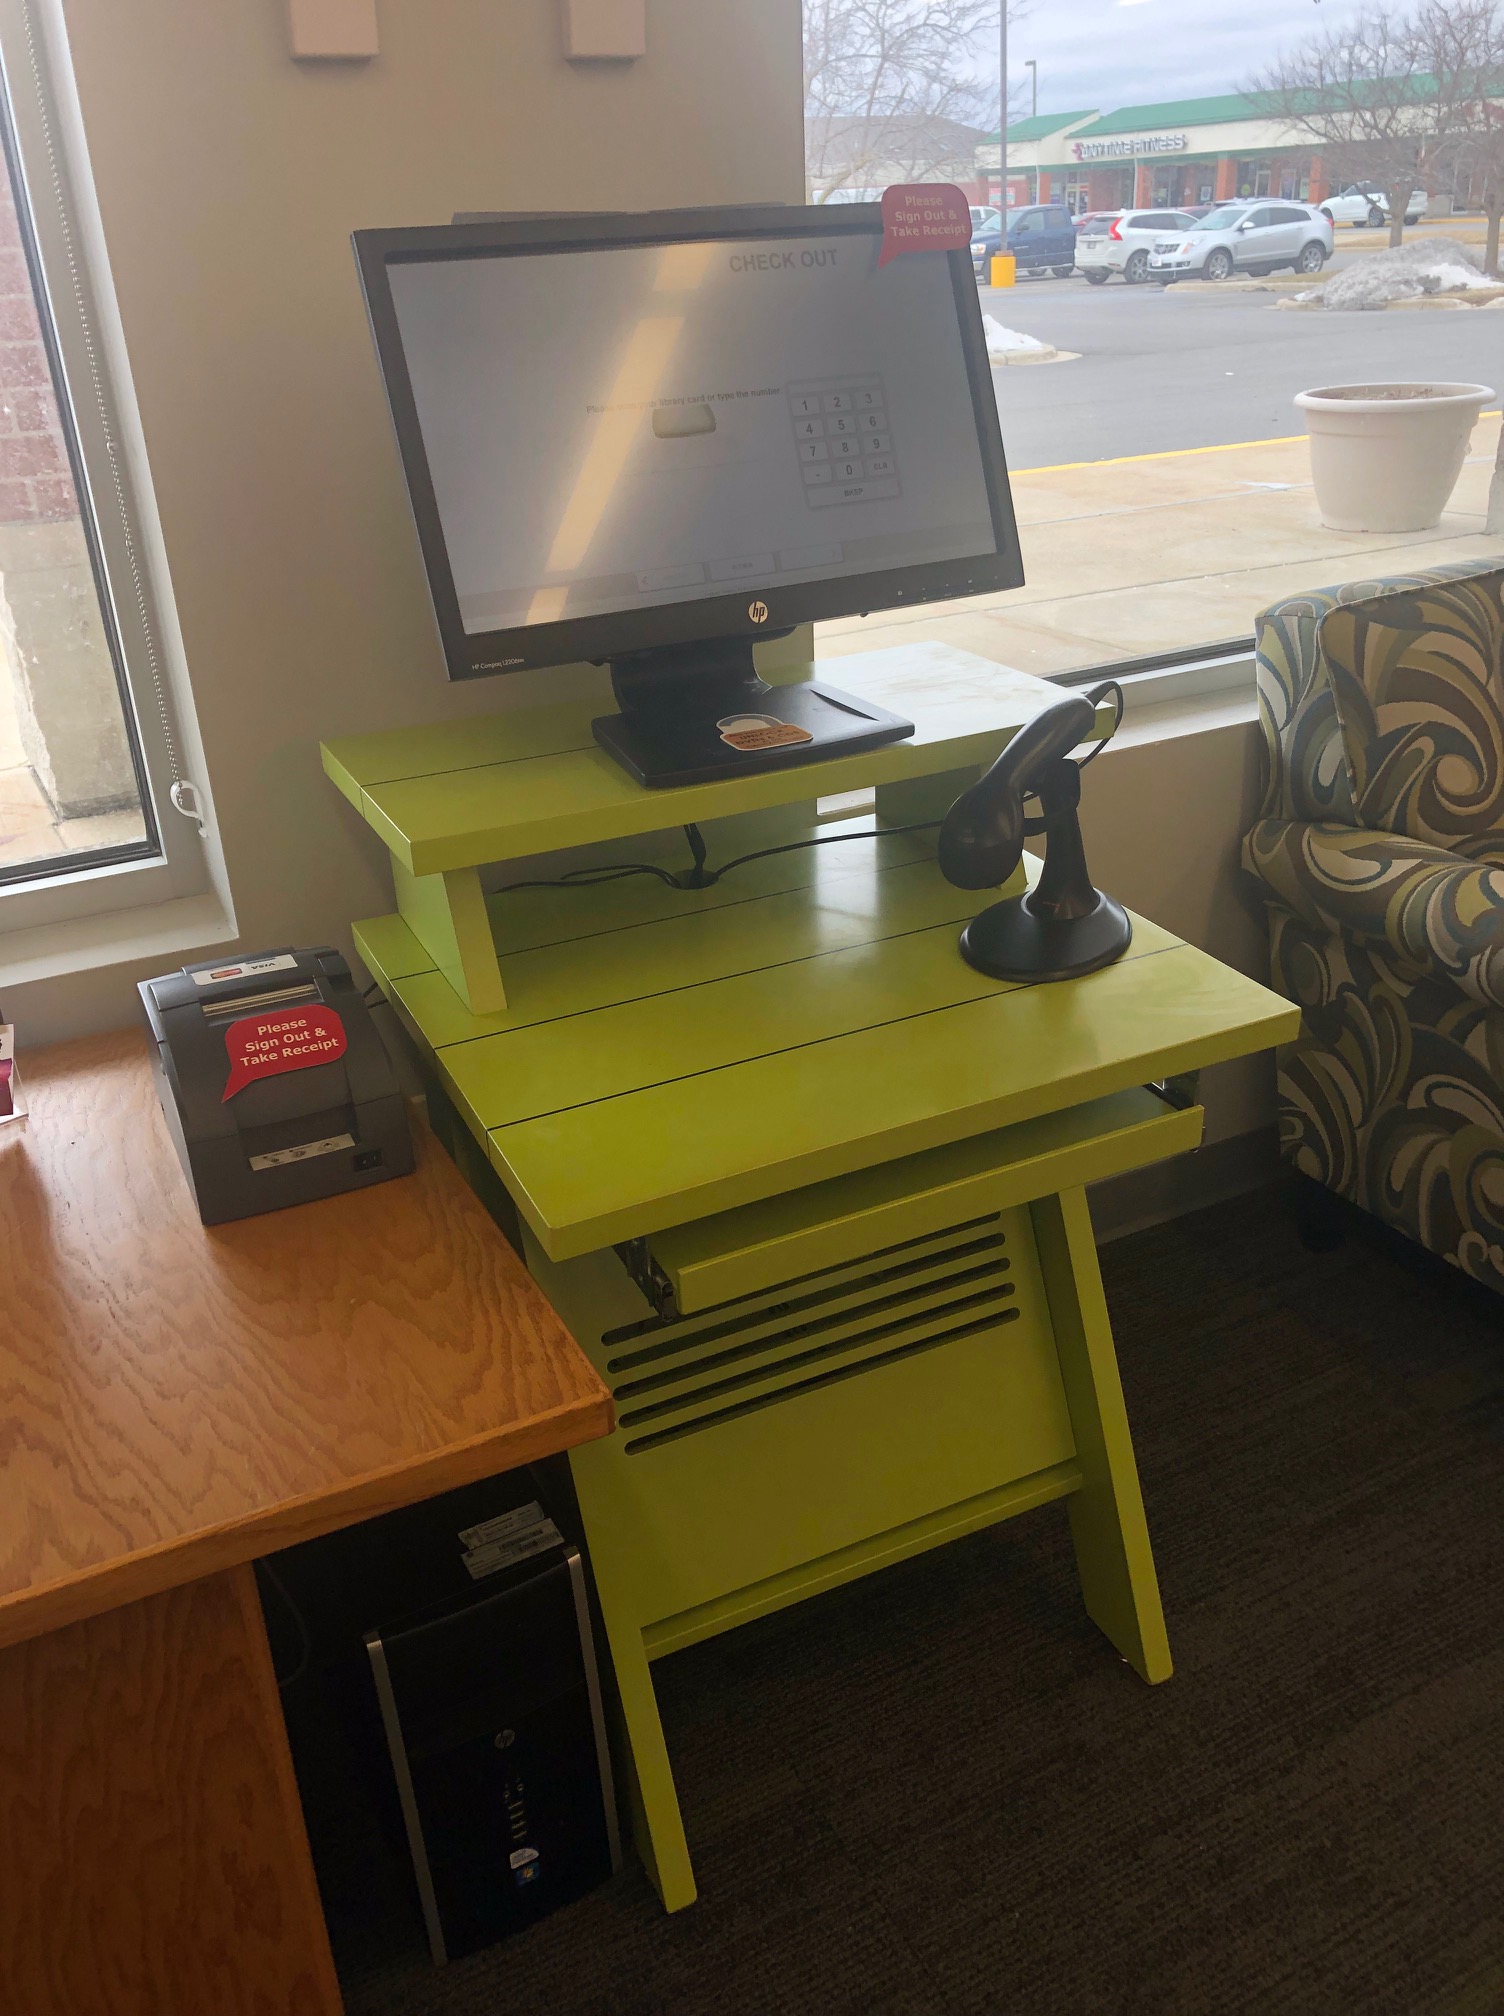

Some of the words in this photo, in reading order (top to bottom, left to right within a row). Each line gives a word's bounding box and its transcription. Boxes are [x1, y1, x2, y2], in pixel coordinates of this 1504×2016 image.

[1133, 134, 1186, 153] FITNESS
[904, 195, 944, 207] Please
[894, 211, 921, 224] Sign
[923, 210, 946, 222] Out
[948, 209, 958, 220] &
[890, 226, 921, 238] Take
[922, 223, 968, 237] Receipt
[728, 251, 797, 273] CHECK
[800, 249, 839, 269] OUT
[658, 396, 686, 407] library
[687, 394, 706, 404] card
[717, 392, 736, 403] type
[735, 389, 750, 399] the
[801, 399, 809, 411] 1
[833, 396, 842, 408] 2
[865, 393, 873, 404] 3
[805, 423, 814, 434] 4
[837, 419, 846, 431] 5
[869, 415, 877, 427] 6
[809, 445, 816, 457] 7
[841, 442, 849, 453] 8
[872, 438, 881, 449] 9
[845, 464, 853, 475] 0
[873, 461, 889, 471] CLR
[843, 487, 864, 497] BKSP
[480, 661, 503, 670] Compaq
[257, 1018, 308, 1036] Please
[244, 1038, 279, 1052] Sign
[282, 1030, 311, 1044] Out
[314, 1027, 327, 1037] &
[239, 1052, 279, 1067] Take
[281, 1037, 340, 1058] Receipt
